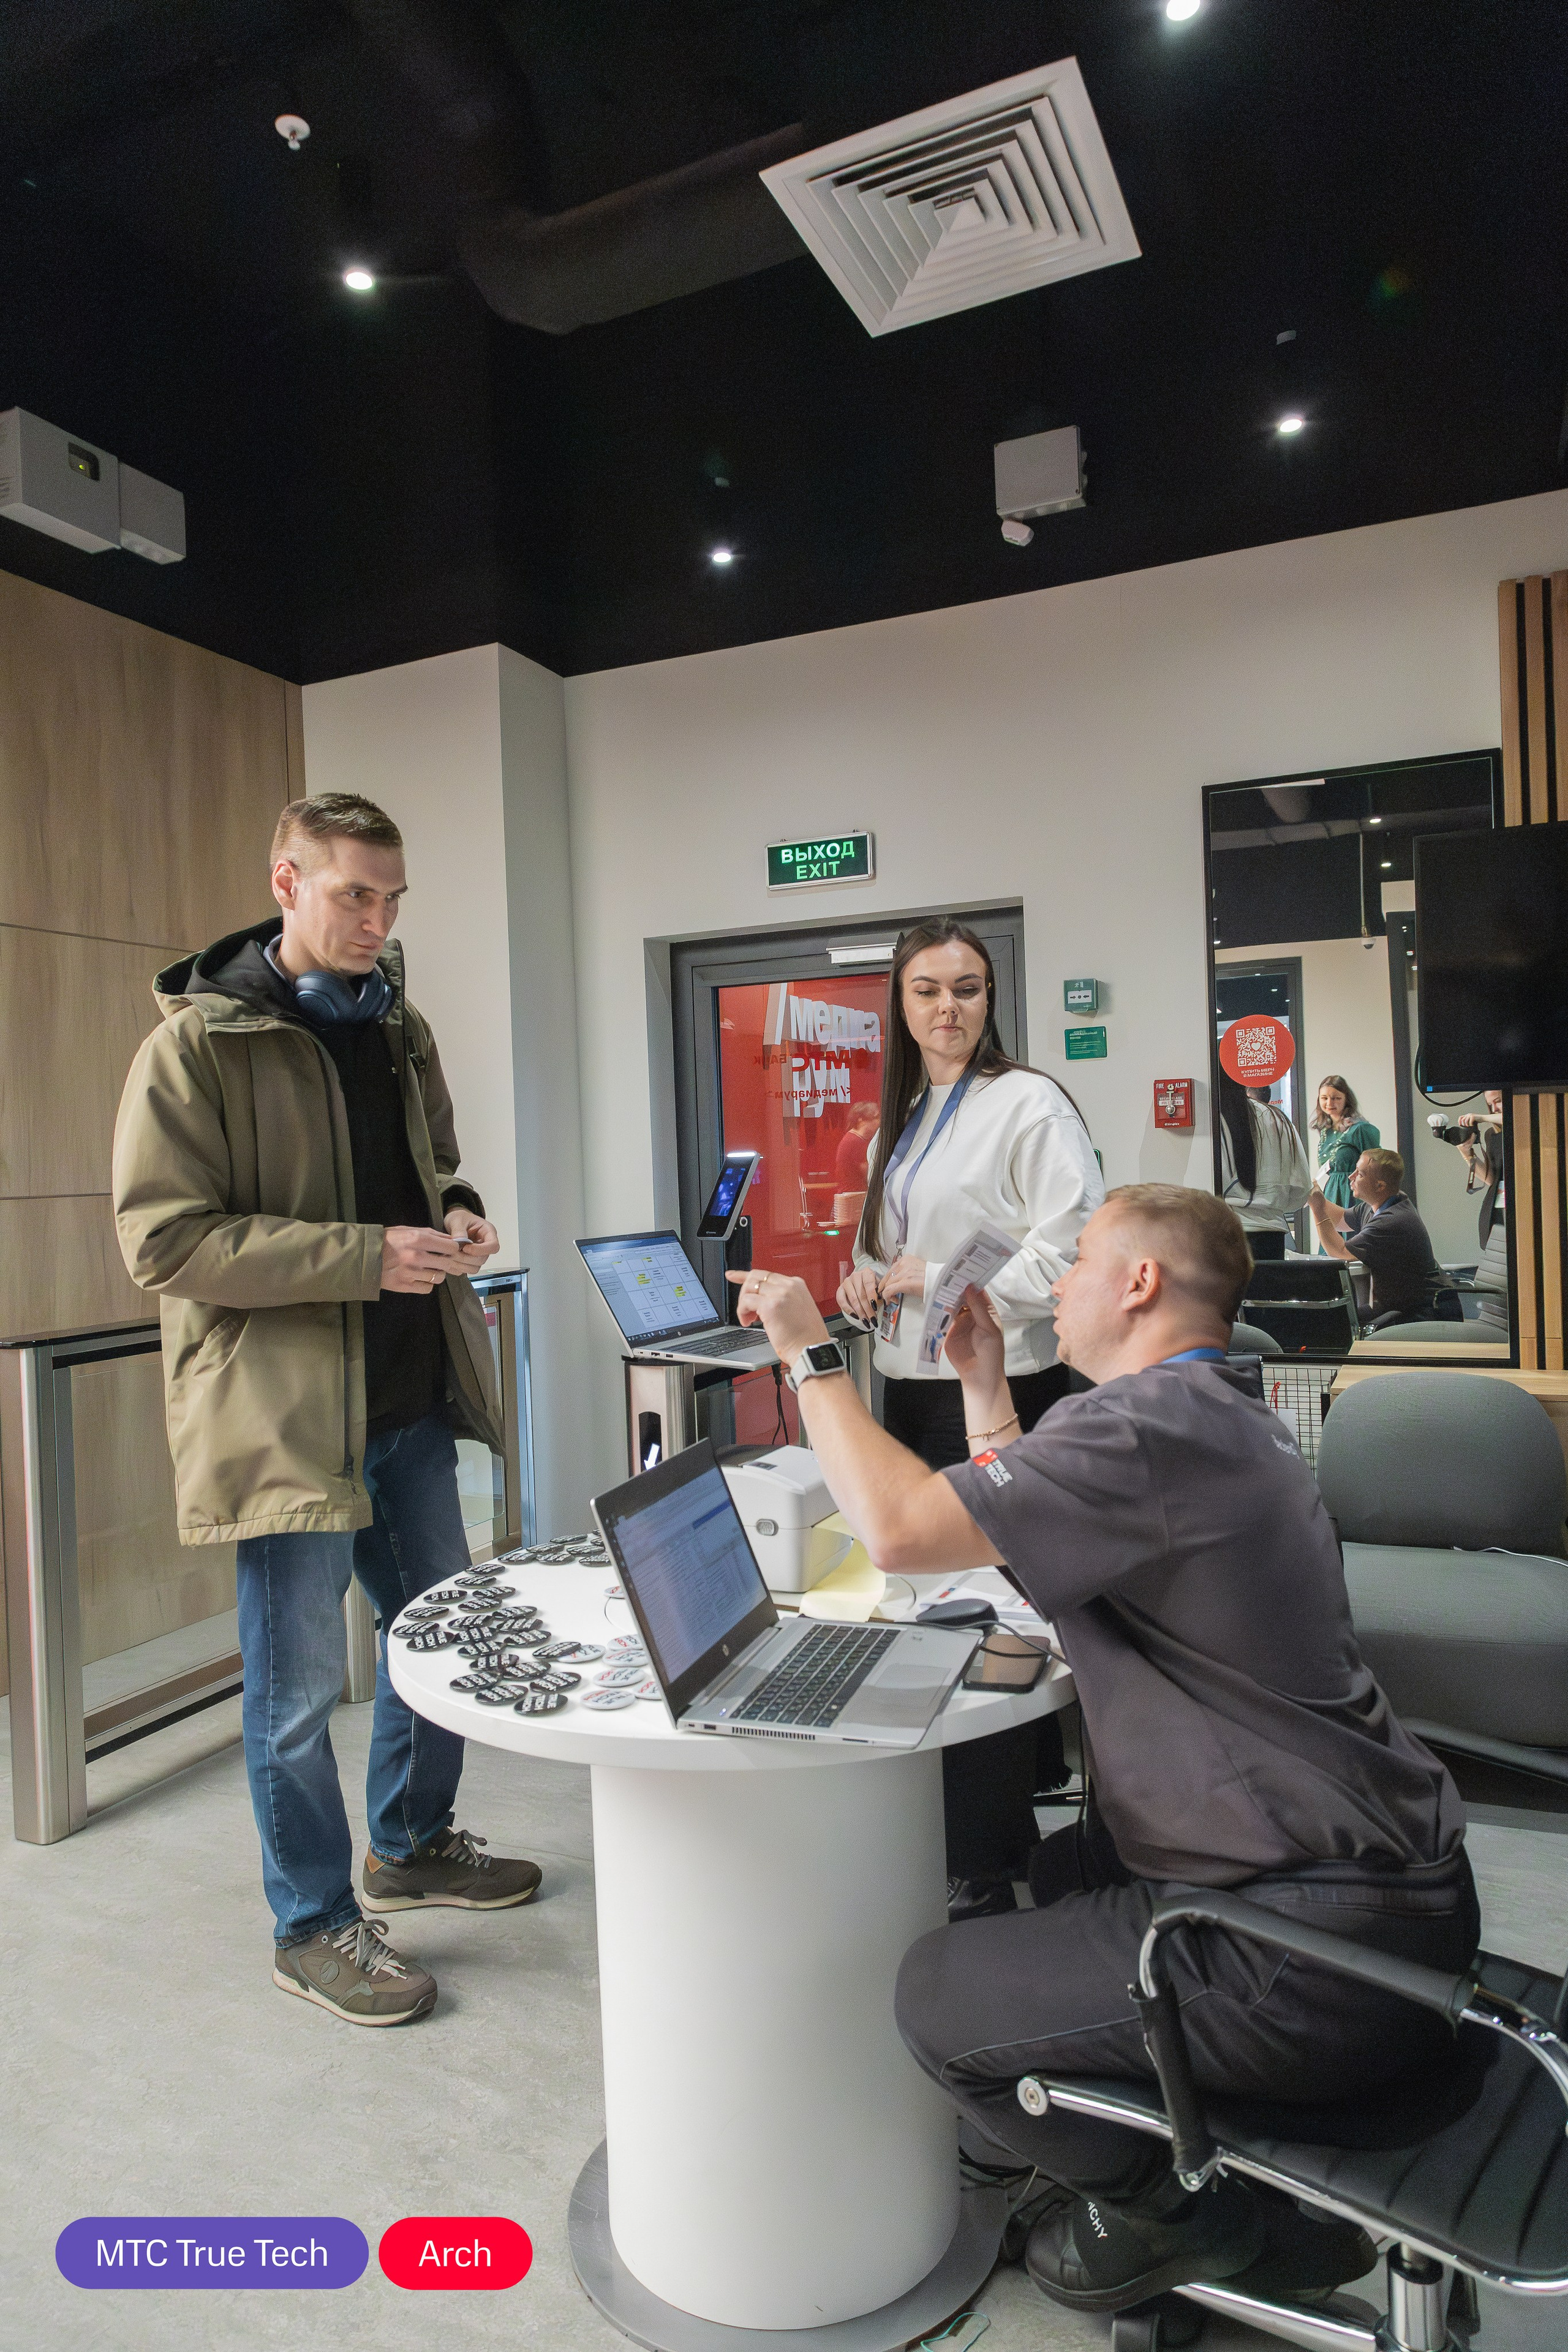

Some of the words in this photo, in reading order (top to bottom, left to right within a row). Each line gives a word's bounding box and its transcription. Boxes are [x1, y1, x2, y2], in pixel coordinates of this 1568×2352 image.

[781, 841, 854, 864] ВЫХОД
[796, 861, 840, 880] EXIT
[985, 1463, 1005, 1488] TECH
[992, 1458, 1013, 1483] TRUE
[425, 1633, 437, 1647] TECH
[436, 1632, 448, 1645] TRUE
[533, 1695, 546, 1710] TECH
[547, 1693, 559, 1709] TRUE
